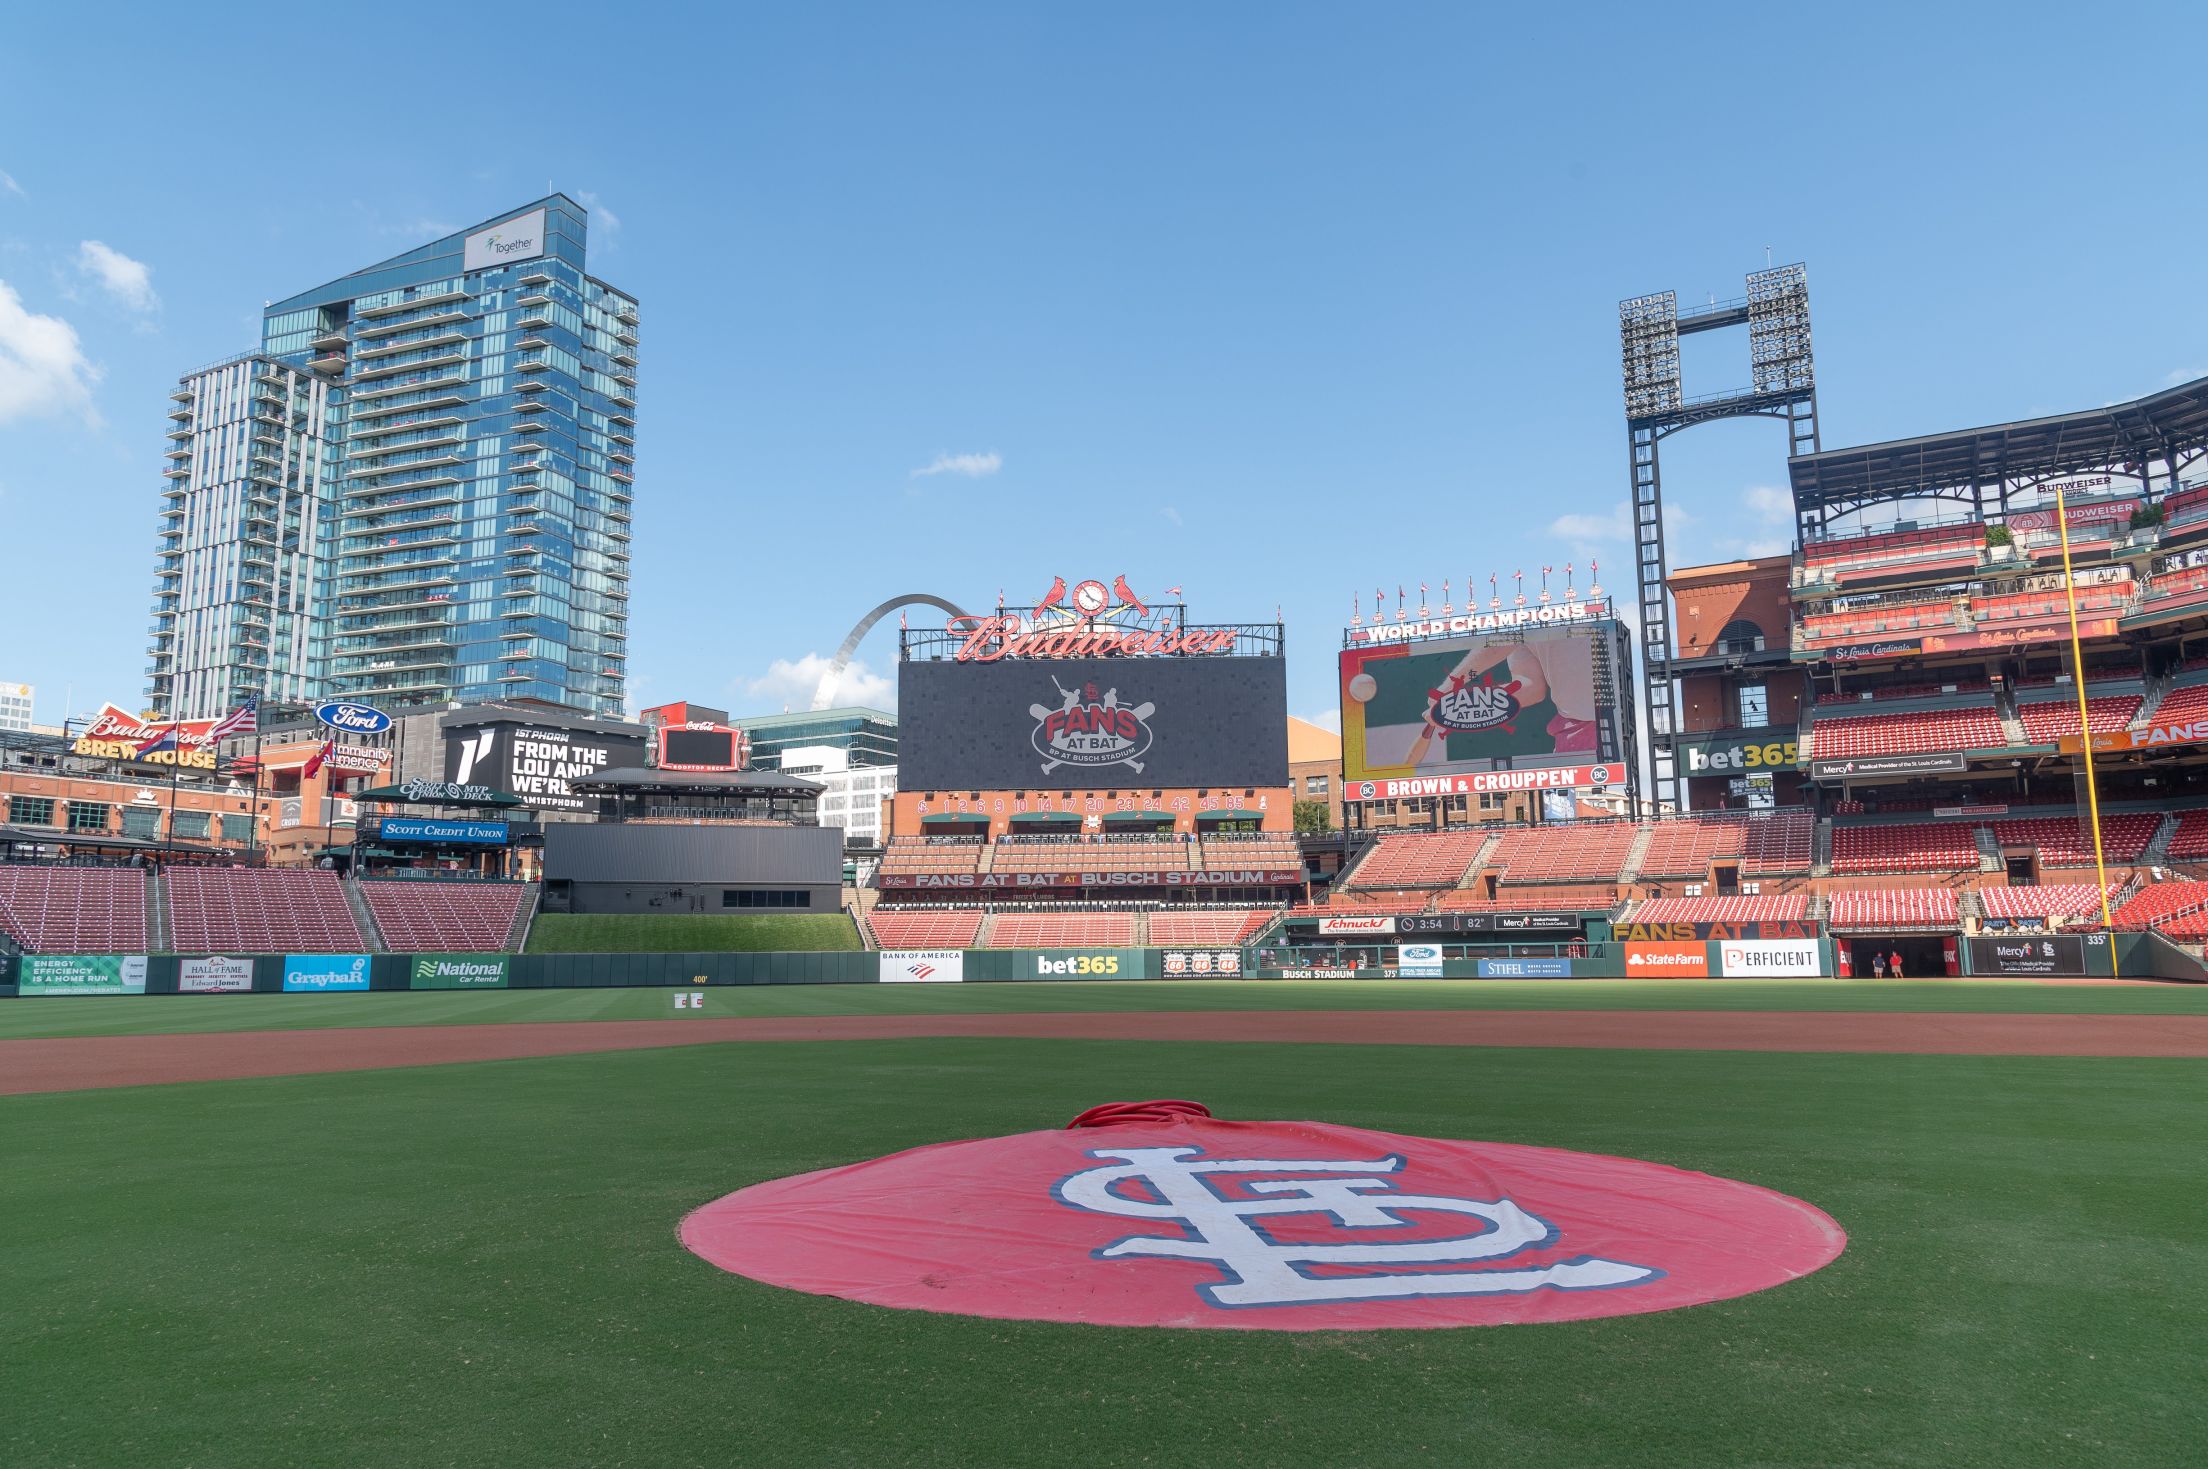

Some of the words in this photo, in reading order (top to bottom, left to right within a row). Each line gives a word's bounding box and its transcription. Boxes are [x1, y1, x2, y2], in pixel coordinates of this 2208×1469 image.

[495, 239, 533, 254] Together
[2037, 477, 2112, 493] BUDWEISER
[1366, 621, 1445, 641] WORLD
[1450, 604, 1586, 632] CHAMPIONS
[947, 615, 1237, 661] Budweiser
[1872, 643, 1911, 657] Cardinals
[1441, 687, 1509, 716] FANS
[333, 706, 378, 729] Ford
[1457, 711, 1470, 720] AT
[1474, 709, 1495, 718] BAT
[686, 721, 715, 731] Coca-Cola
[1045, 706, 1137, 743] FANS
[1483, 715, 1508, 727] STADIUM
[531, 730, 570, 742] PHORM
[2130, 721, 2208, 746] FANS
[75, 738, 138, 760] BREW
[1067, 738, 1085, 749] AT
[1090, 738, 1118, 749] BAT
[514, 741, 568, 761] FROM
[572, 748, 608, 766] THE
[1049, 748, 1060, 756] BP
[1073, 754, 1100, 762] BUSCH
[1101, 747, 1136, 760] STADIUM
[1688, 743, 1799, 771] bet365
[330, 754, 379, 769] merica
[513, 757, 550, 776] LOU
[1823, 766, 1848, 774] Mercy
[411, 777, 446, 789] SCOTT
[1387, 778, 1452, 796] BROWN
[1457, 780, 1468, 792] &
[1473, 768, 1576, 791] CROUPPEN
[1729, 778, 1771, 788] bet365
[400, 783, 441, 795] CREDIT
[409, 789, 446, 800] UNION
[463, 784, 489, 793] MVP
[462, 792, 494, 801] DECK
[943, 800, 950, 813] 1
[958, 800, 968, 813] 2
[976, 799, 985, 813] 6
[995, 799, 1004, 812] 9
[1014, 799, 1027, 812] 10
[1037, 799, 1052, 812] 14
[1062, 799, 1077, 812] 17
[1086, 798, 1105, 811] 20
[1116, 798, 1135, 811] 23
[1144, 797, 1162, 811] 24
[1171, 797, 1189, 811] 42
[1200, 797, 1219, 810] 45
[1225, 797, 1244, 810] 85
[385, 823, 422, 834] SCOTT
[424, 825, 466, 837] CREDIT
[467, 827, 503, 838] UNION
[915, 874, 975, 887] FANS
[981, 874, 1009, 886] AT
[1017, 873, 1059, 886] BAT
[1064, 875, 1077, 884] AT
[1081, 872, 1159, 885] BUSCH
[1166, 871, 1264, 884] STADIUM
[1325, 919, 1388, 928] Schnucks
[1419, 919, 1443, 929] 3:54
[1467, 918, 1485, 928] 82°
[1503, 919, 1525, 928] Mercy
[1613, 922, 1697, 941] FANS
[1707, 922, 1747, 940] AT
[1758, 921, 1819, 939] BAT
[2087, 936, 2106, 945] 335'
[1410, 949, 1430, 958] Ford
[1997, 947, 2024, 957] Mercy
[191, 966, 213, 974] HALL
[222, 966, 242, 974] FAME
[1038, 955, 1118, 974] bet365
[1169, 961, 1182, 969] 66
[1195, 961, 1207, 969] 66
[1221, 961, 1234, 969] 66
[1488, 962, 1525, 975] STIFEL
[33, 975, 41, 983] IS
[693, 975, 708, 984] 400'
[1282, 970, 1312, 979] BUSCH
[1314, 970, 1355, 979] STADIUM
[1384, 970, 1398, 978] 375'
[192, 979, 218, 987] Edward
[218, 979, 240, 987] Jones
